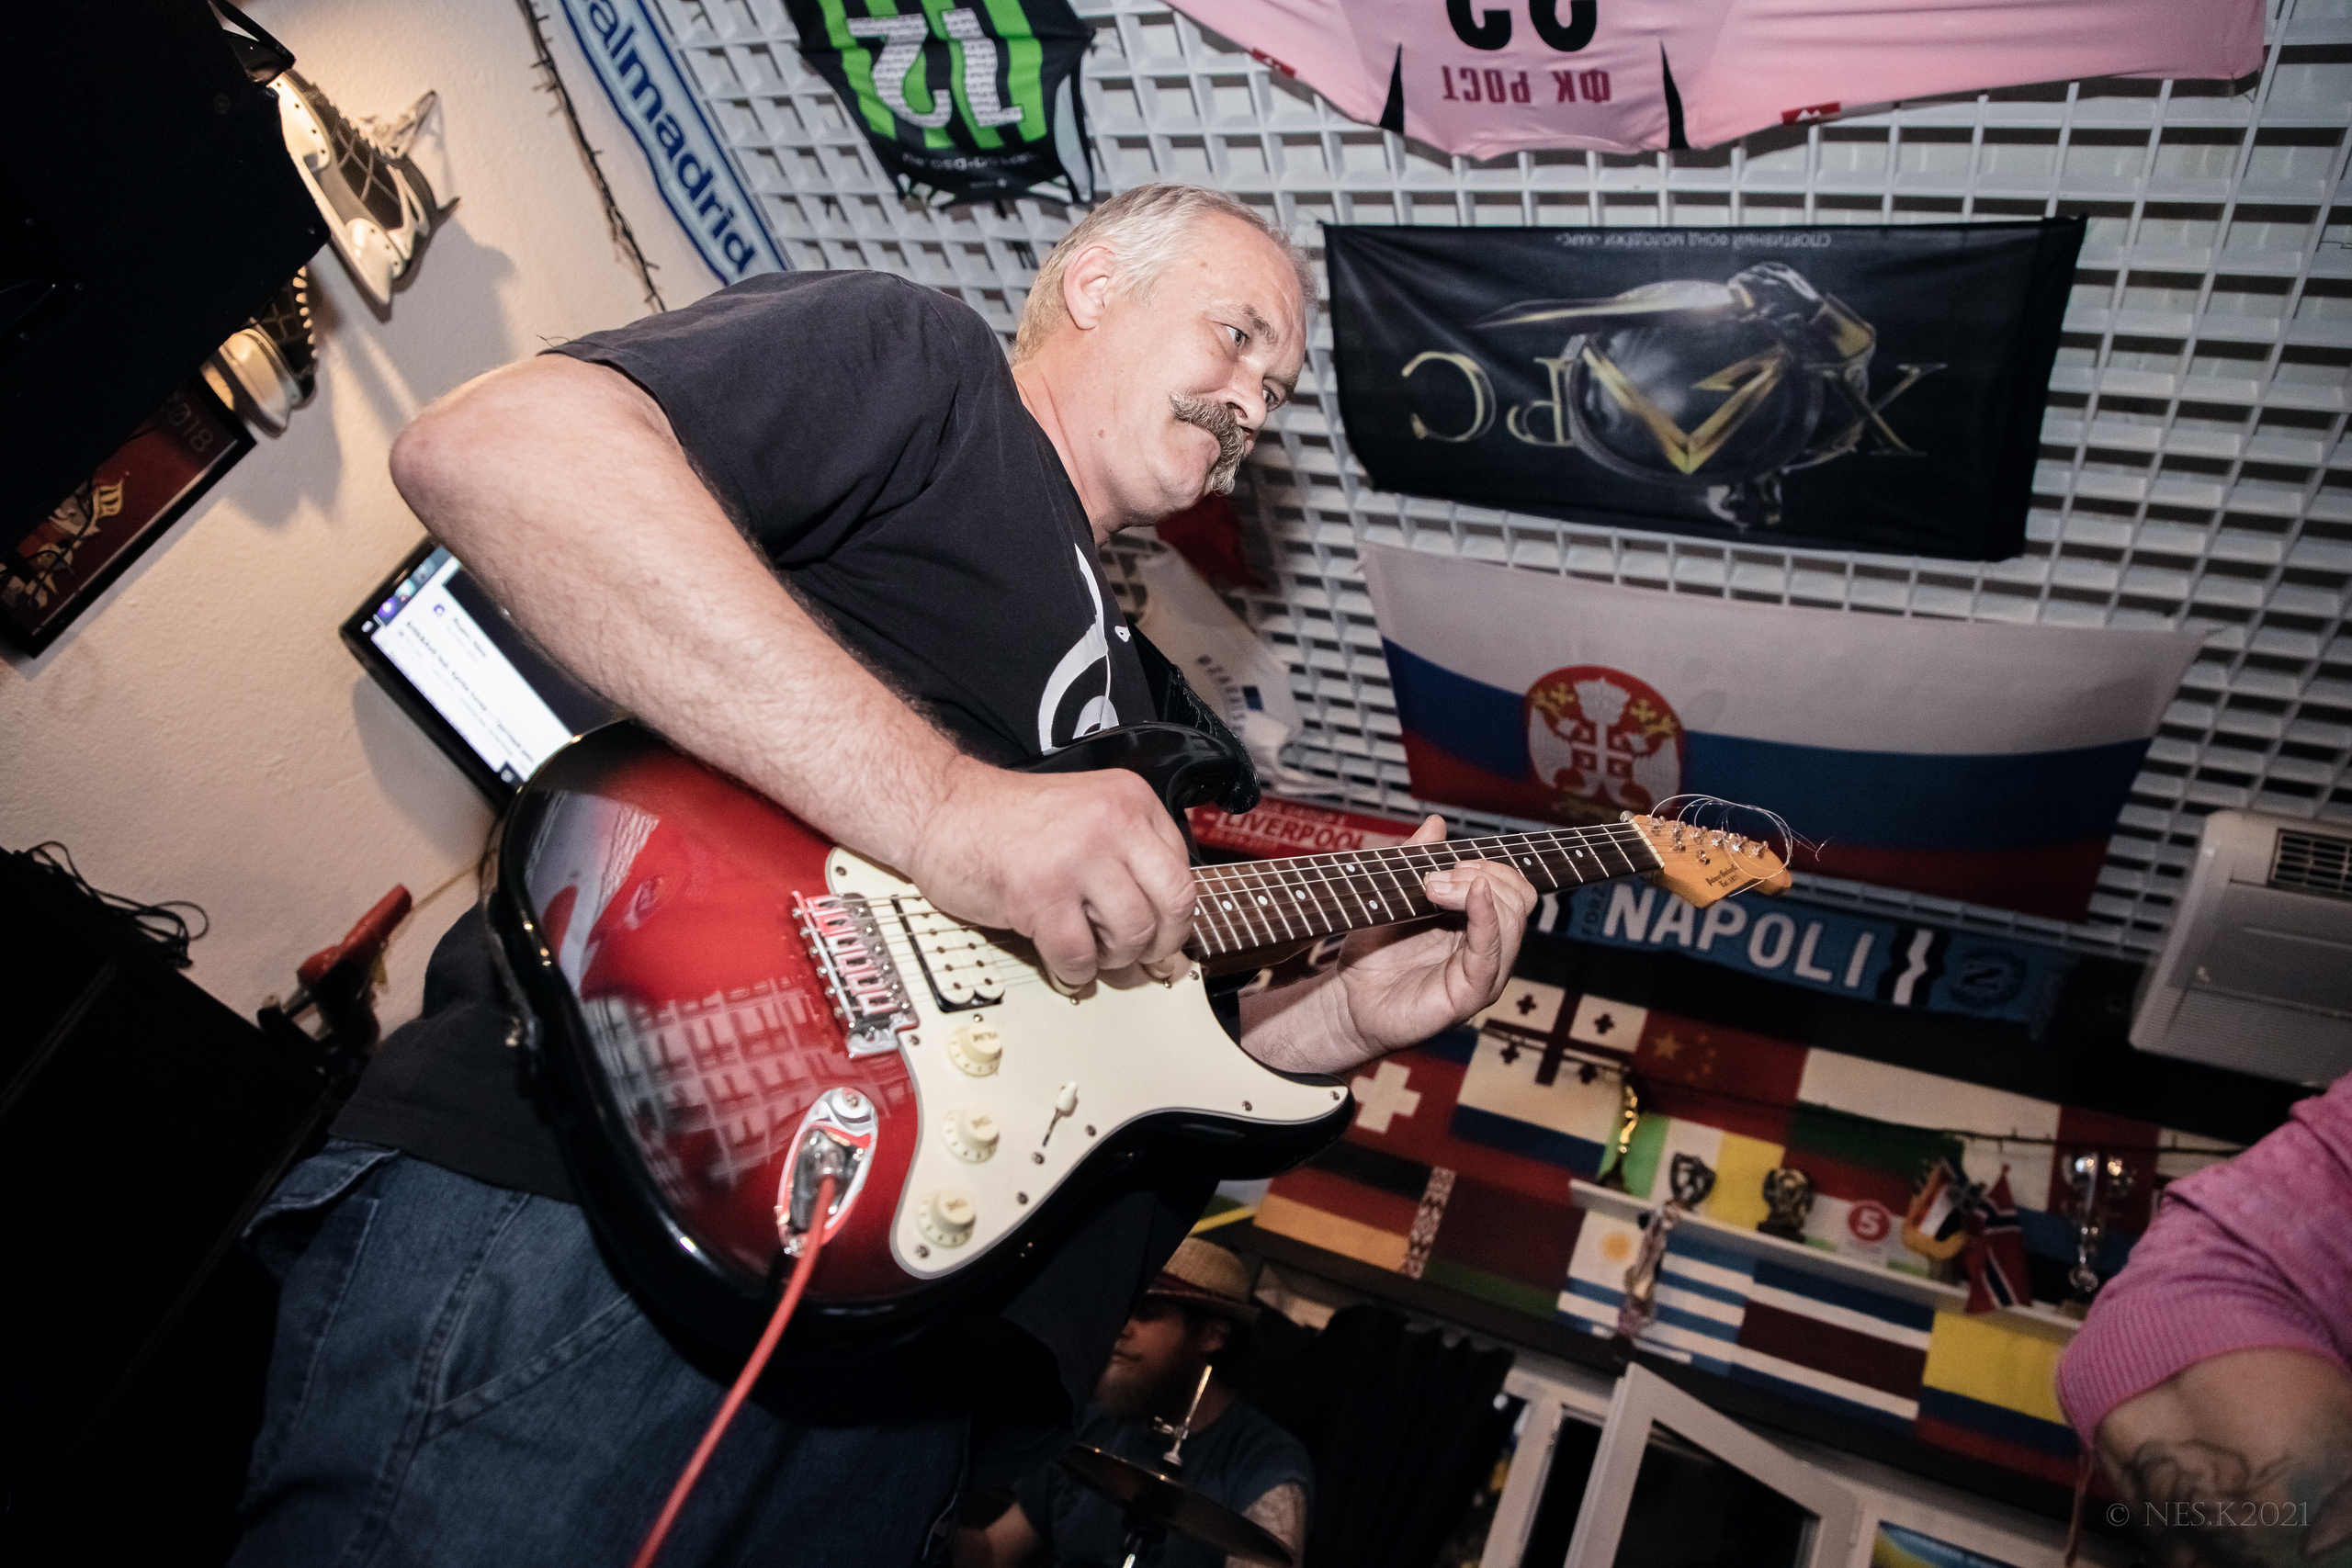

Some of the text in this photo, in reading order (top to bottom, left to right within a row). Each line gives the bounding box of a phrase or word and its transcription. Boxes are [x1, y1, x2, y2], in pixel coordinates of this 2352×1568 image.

[846, 7, 1023, 129] 12
[1441, 65, 1611, 104] ФК РОСТ
[1215, 810, 1364, 851] LIVERPOOL
[1603, 883, 1874, 988] NAPOLI
